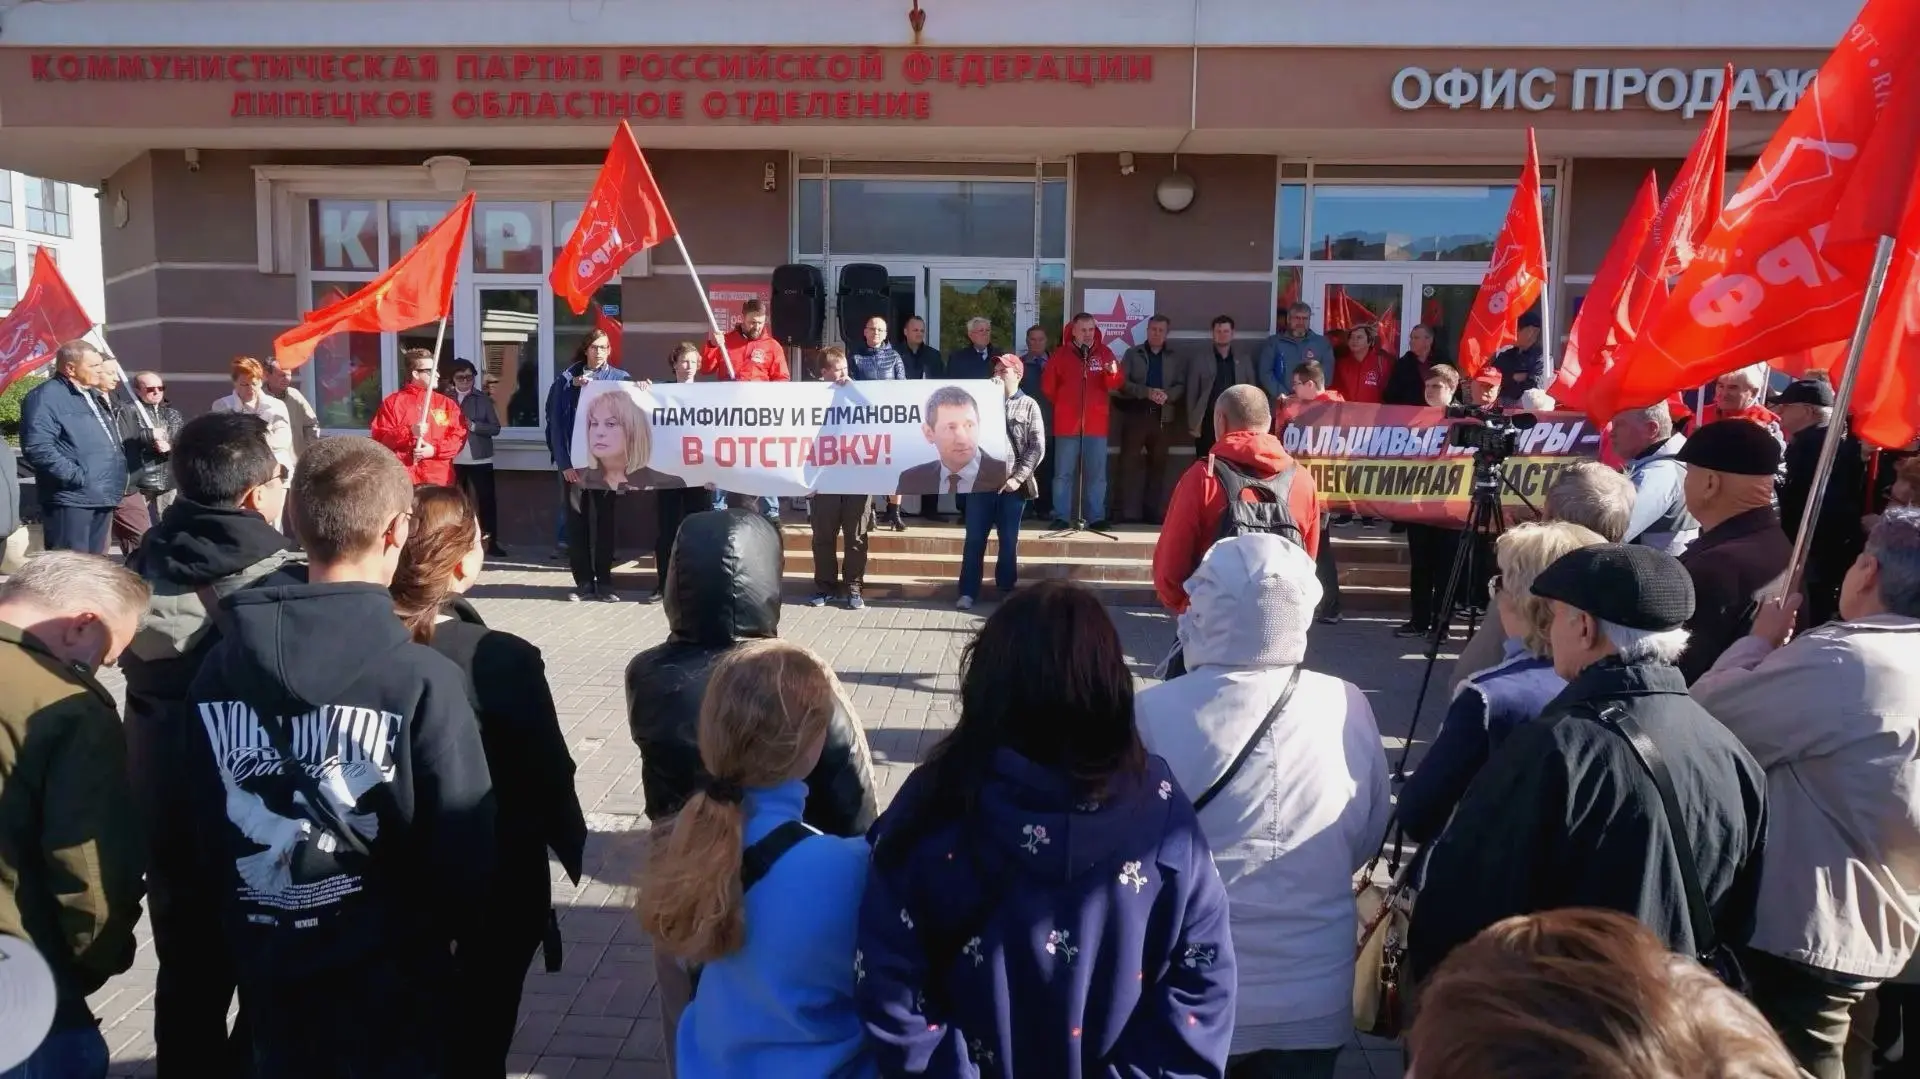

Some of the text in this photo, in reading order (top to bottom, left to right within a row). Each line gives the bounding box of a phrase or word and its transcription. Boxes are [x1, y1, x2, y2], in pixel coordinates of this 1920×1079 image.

[31, 49, 1155, 87] КОММУНИСТИЧЕСКАЯ ПАРТИЯ РОССИЙСКОЙ ФЕДЕРАЦИИ
[230, 91, 931, 123] ЛИПЕЦКОЕ ОБЛАСТНОЕ ОТДЕЛЕНИЕ
[1391, 66, 1556, 111] ОФИС
[1571, 67, 1819, 119] ПРОДАЖ
[652, 404, 922, 427] ПАМФИЛОВУ И ЕЛМАНОВА
[682, 434, 892, 468] В ОТСТАВКУ!
[1283, 423, 1449, 457] ФАЛЬШИВЫЕ
[1303, 463, 1465, 497] ЛЕГИТИМНАЯ
[198, 701, 403, 782] WORDWIDE
